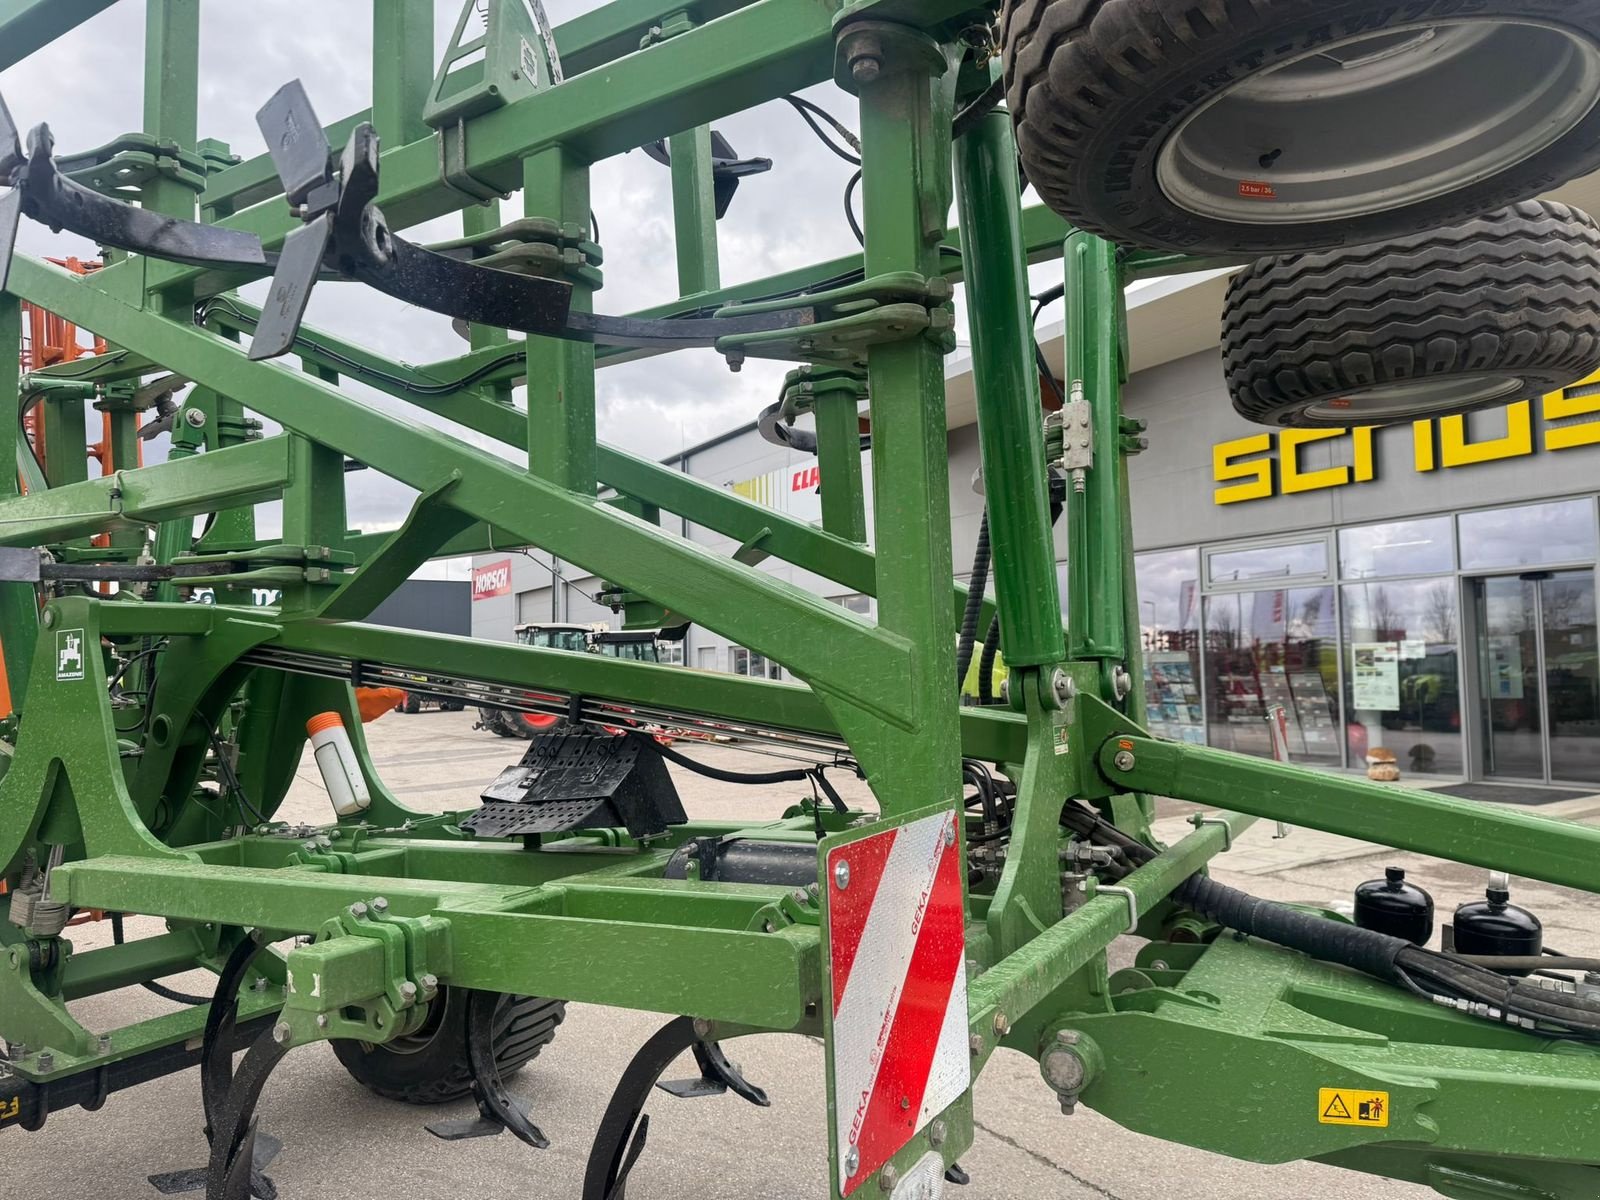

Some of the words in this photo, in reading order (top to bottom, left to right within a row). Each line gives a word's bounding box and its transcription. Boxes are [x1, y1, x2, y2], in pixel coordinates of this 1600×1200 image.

[475, 567, 508, 594] HORSCH
[911, 891, 928, 936] GEKA
[849, 1090, 870, 1145] GEKA
